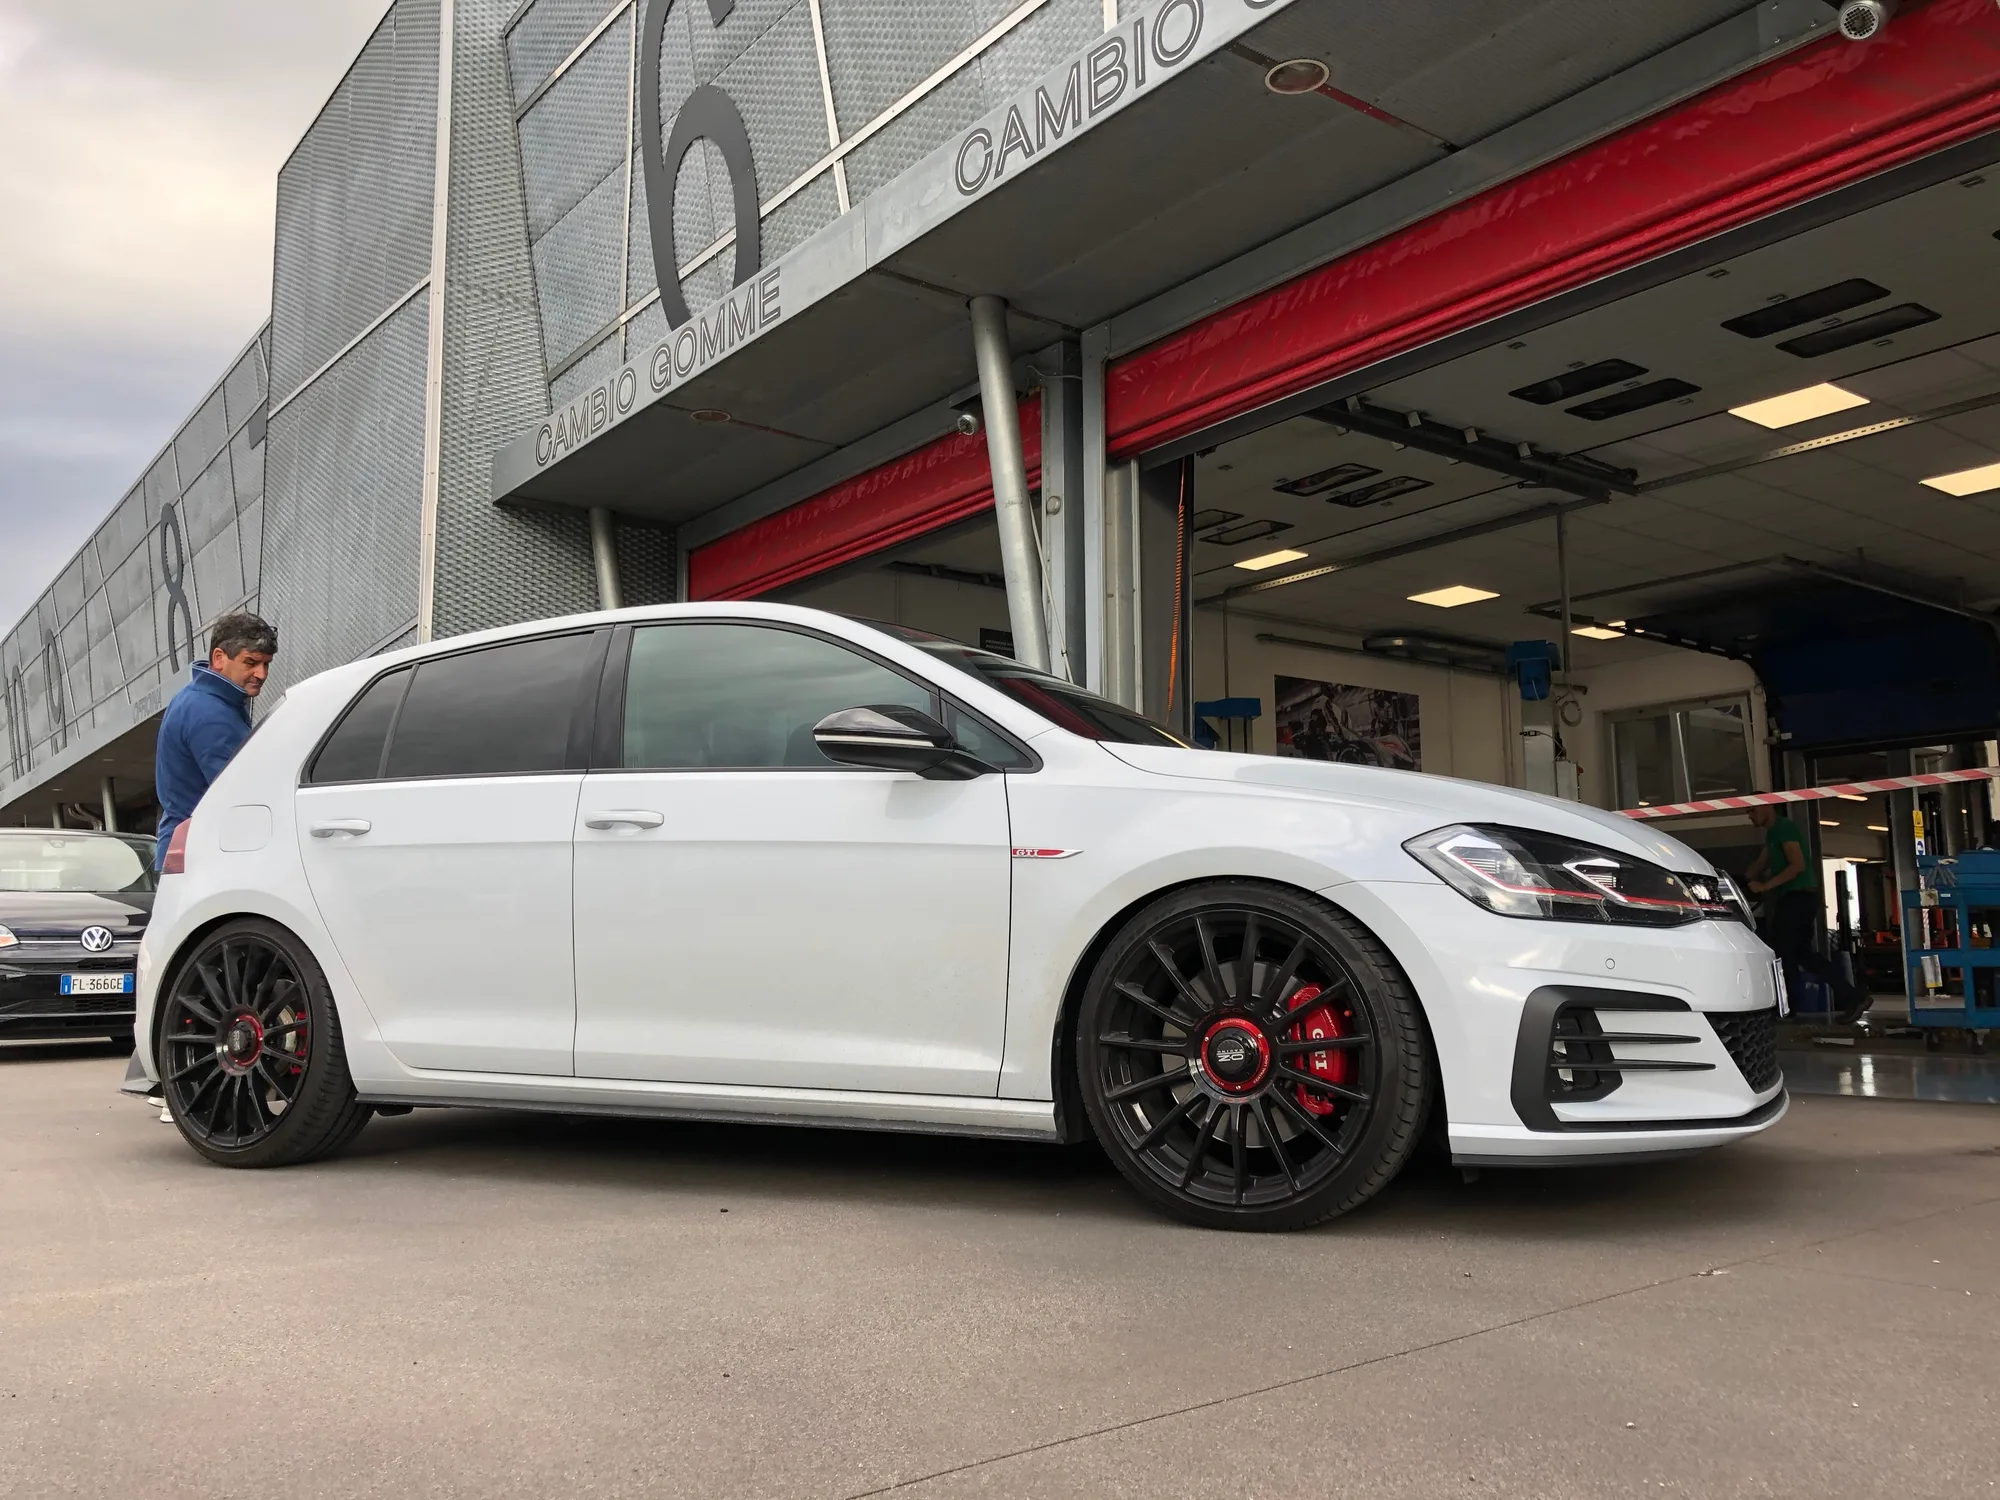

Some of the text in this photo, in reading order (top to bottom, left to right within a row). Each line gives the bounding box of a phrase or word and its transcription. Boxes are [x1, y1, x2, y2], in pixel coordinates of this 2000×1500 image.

[955, 0, 1204, 197] CAMBIO
[535, 266, 781, 468] CAMBIO GOMME
[160, 503, 195, 675] 8
[1015, 849, 1034, 858] GTI
